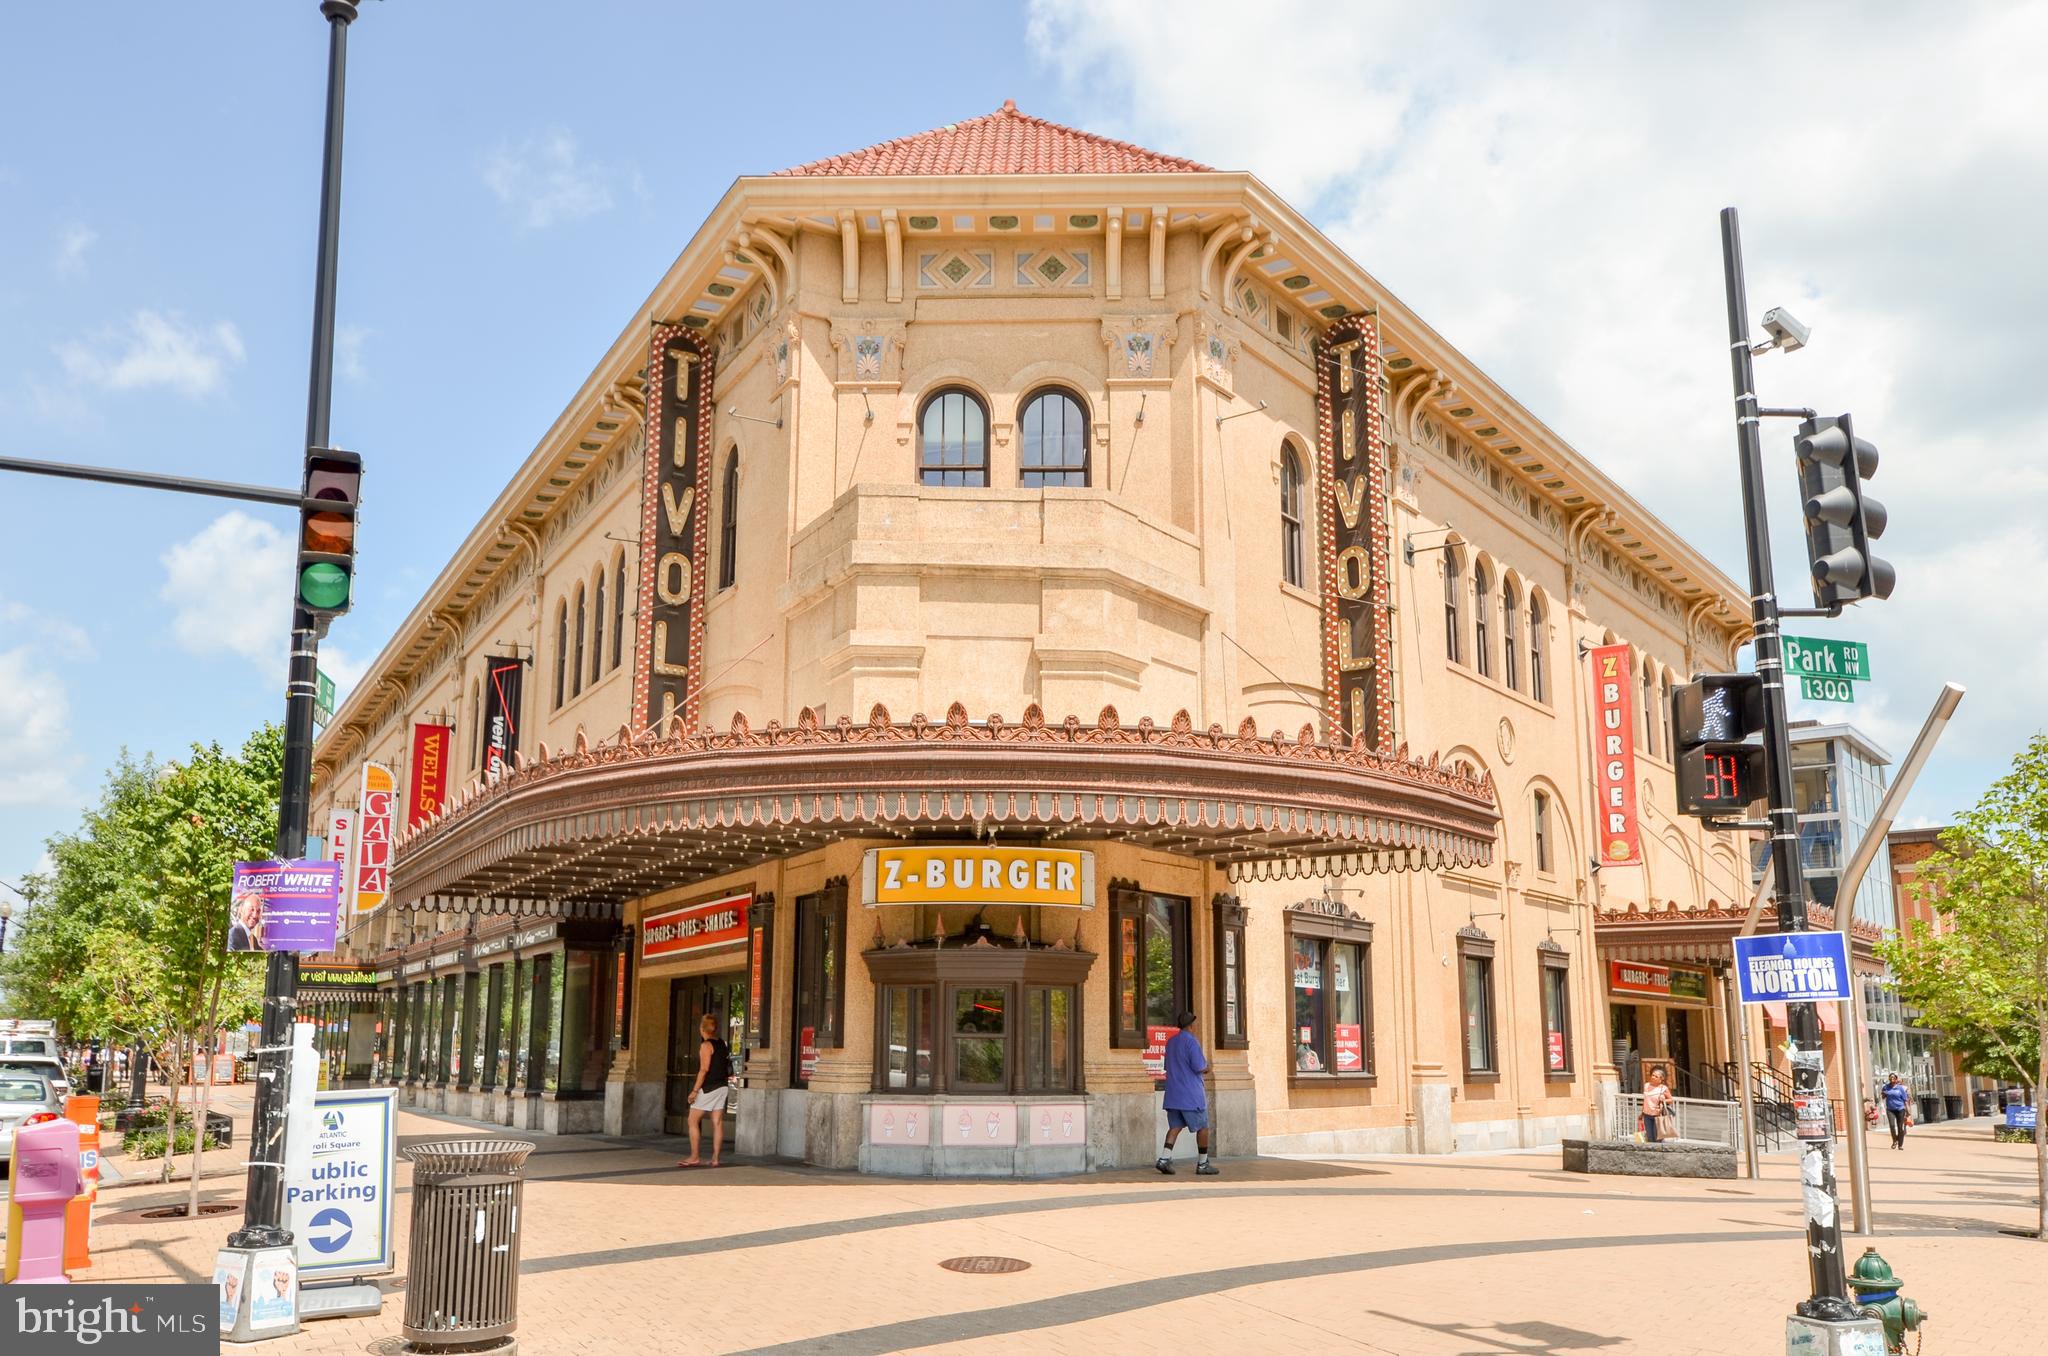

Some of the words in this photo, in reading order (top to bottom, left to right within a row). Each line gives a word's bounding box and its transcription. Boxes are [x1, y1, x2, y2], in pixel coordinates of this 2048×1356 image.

[654, 347, 700, 737] TIVOLI
[1329, 338, 1375, 742] TIVOLI
[1787, 641, 1838, 673] Park
[1843, 646, 1859, 660] RD
[1845, 661, 1859, 675] NW
[1805, 679, 1850, 701] 1300
[419, 733, 441, 813] WELLS
[361, 792, 391, 894] GALA
[237, 874, 282, 887] ROBERT
[284, 873, 334, 887] WHITE
[883, 858, 1076, 891] Z-BURGER
[677, 918, 696, 938] FRIES
[704, 910, 733, 932] SHAKES
[1748, 958, 1793, 972] ELEANOR
[1793, 957, 1835, 970] HOLMES
[311, 970, 327, 983] visit
[1304, 971, 1320, 987] Burg
[1750, 968, 1838, 994] NORTON
[1154, 1032, 1167, 1041] FREE
[319, 1131, 347, 1139] ATLANTIC
[330, 1140, 361, 1151] Square
[311, 1161, 368, 1180] ublic
[287, 1182, 376, 1203] Parking
